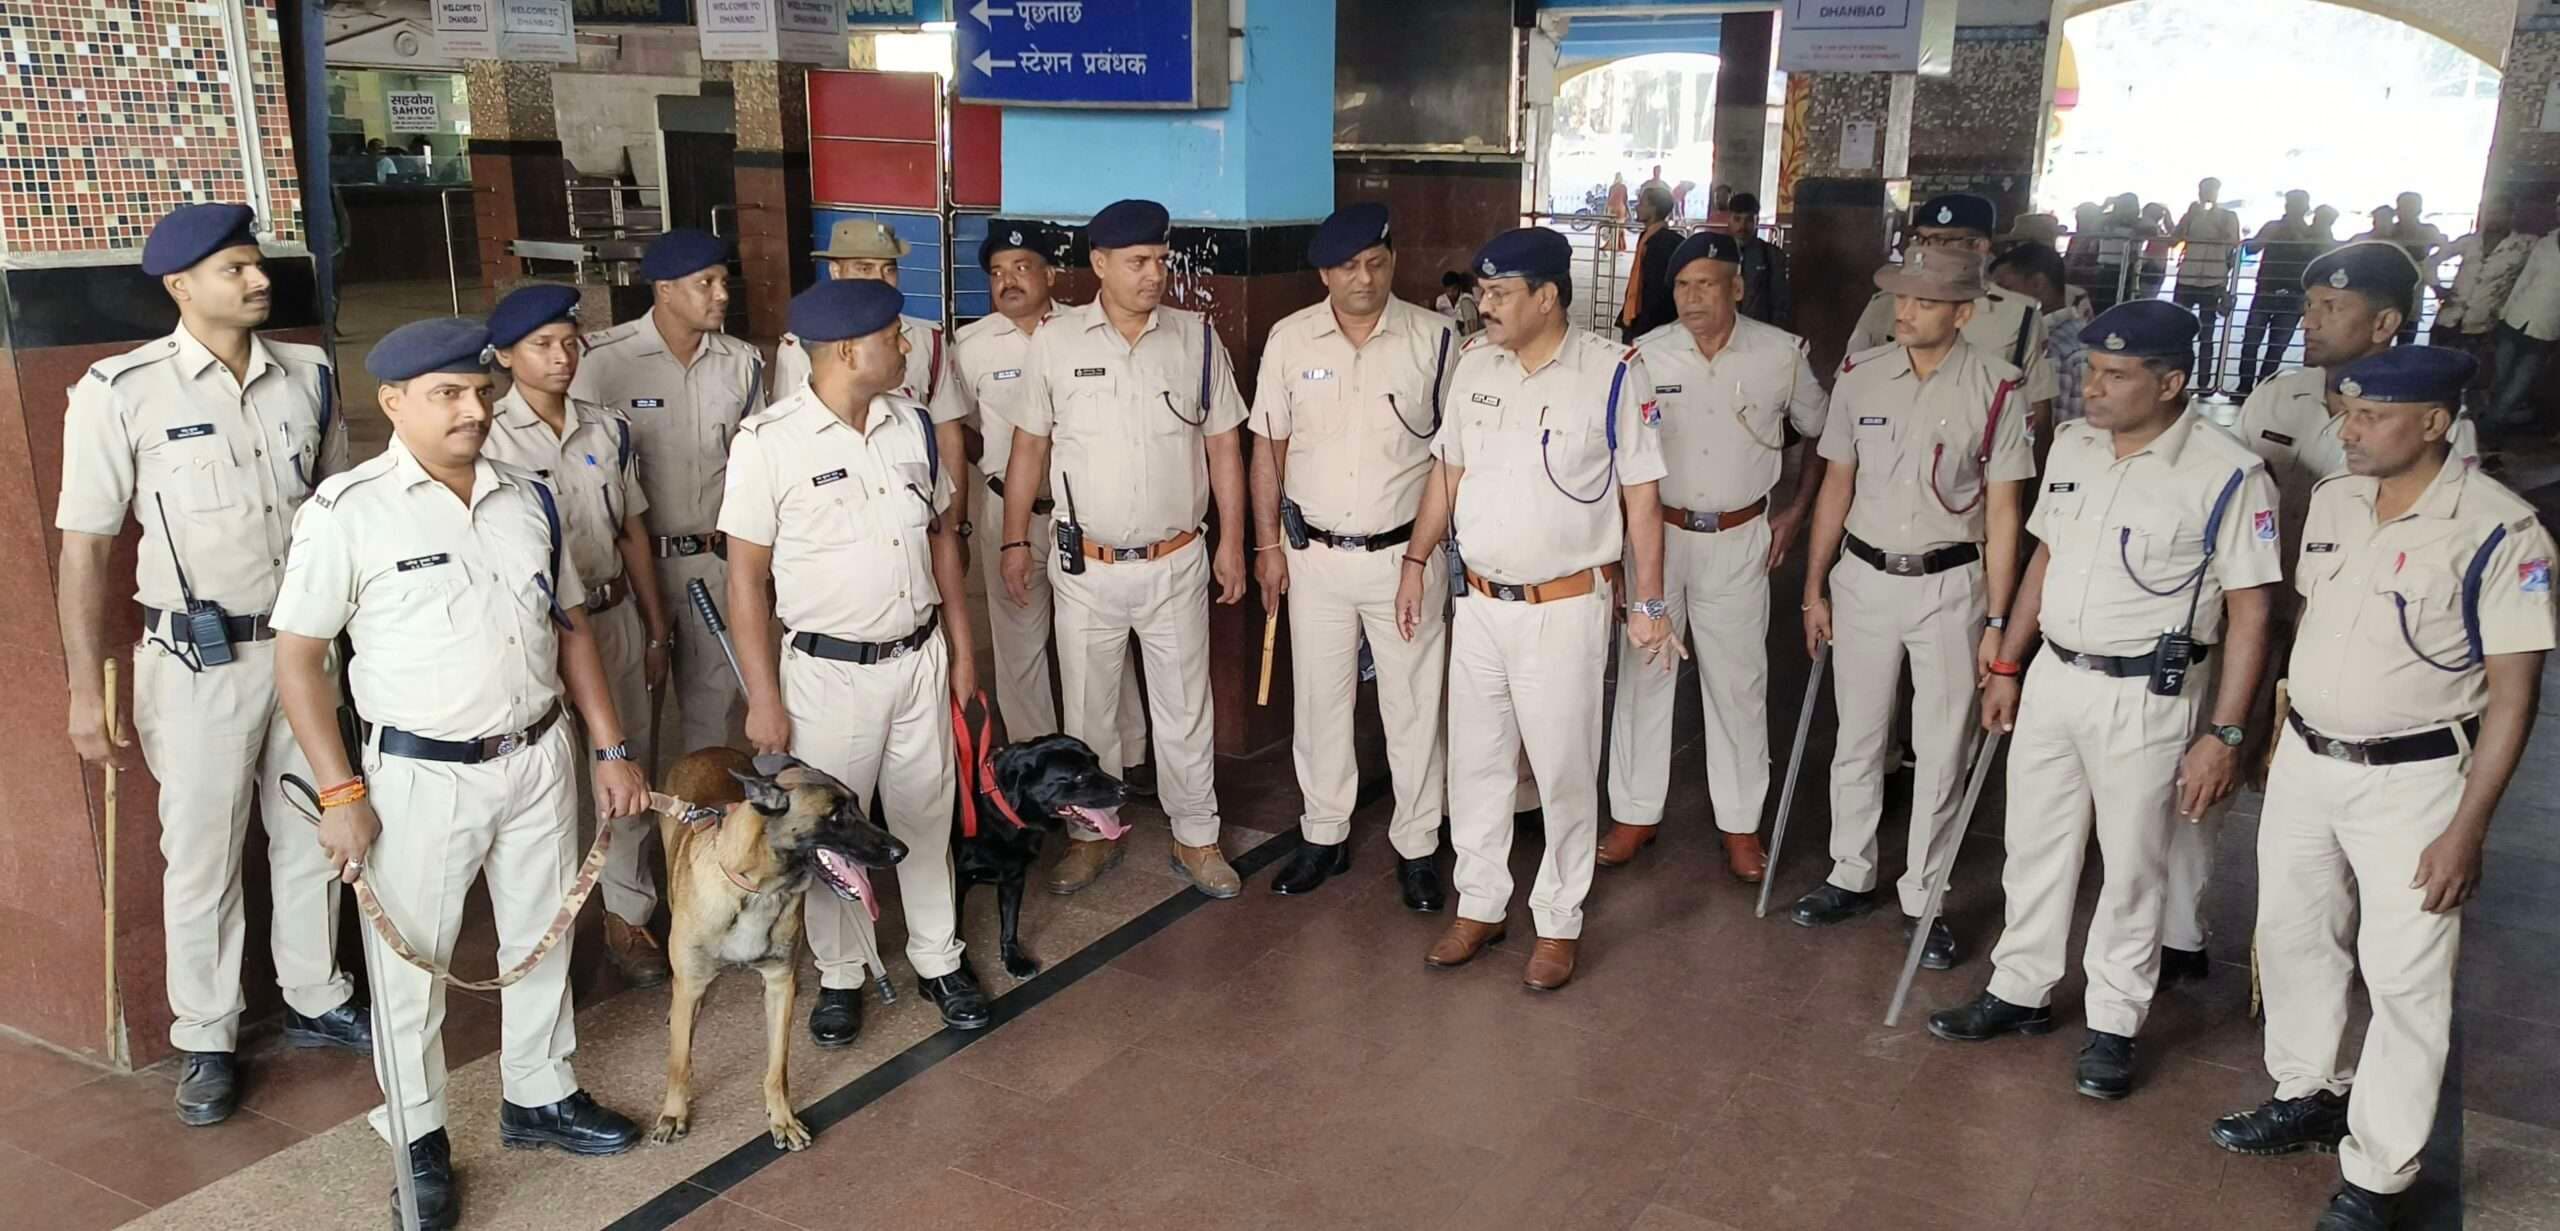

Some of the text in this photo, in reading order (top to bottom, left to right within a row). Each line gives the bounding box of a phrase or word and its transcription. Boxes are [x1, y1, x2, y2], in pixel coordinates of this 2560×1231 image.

[443, 4, 482, 12] WELCOME TO
[511, 6, 547, 15] WELCOME
[713, 1, 760, 11] WELCOME TO
[1016, 2, 1083, 31] पूछताछ
[1819, 5, 1886, 18] DHANBAD
[448, 15, 478, 24] DHANBAD
[719, 15, 756, 24] DHANBAD
[1018, 44, 1148, 75] स्टेशन प्रबंधक
[390, 93, 433, 105] सहयोग
[392, 106, 435, 115] SAHYOG
[2164, 674, 2177, 689] 5
